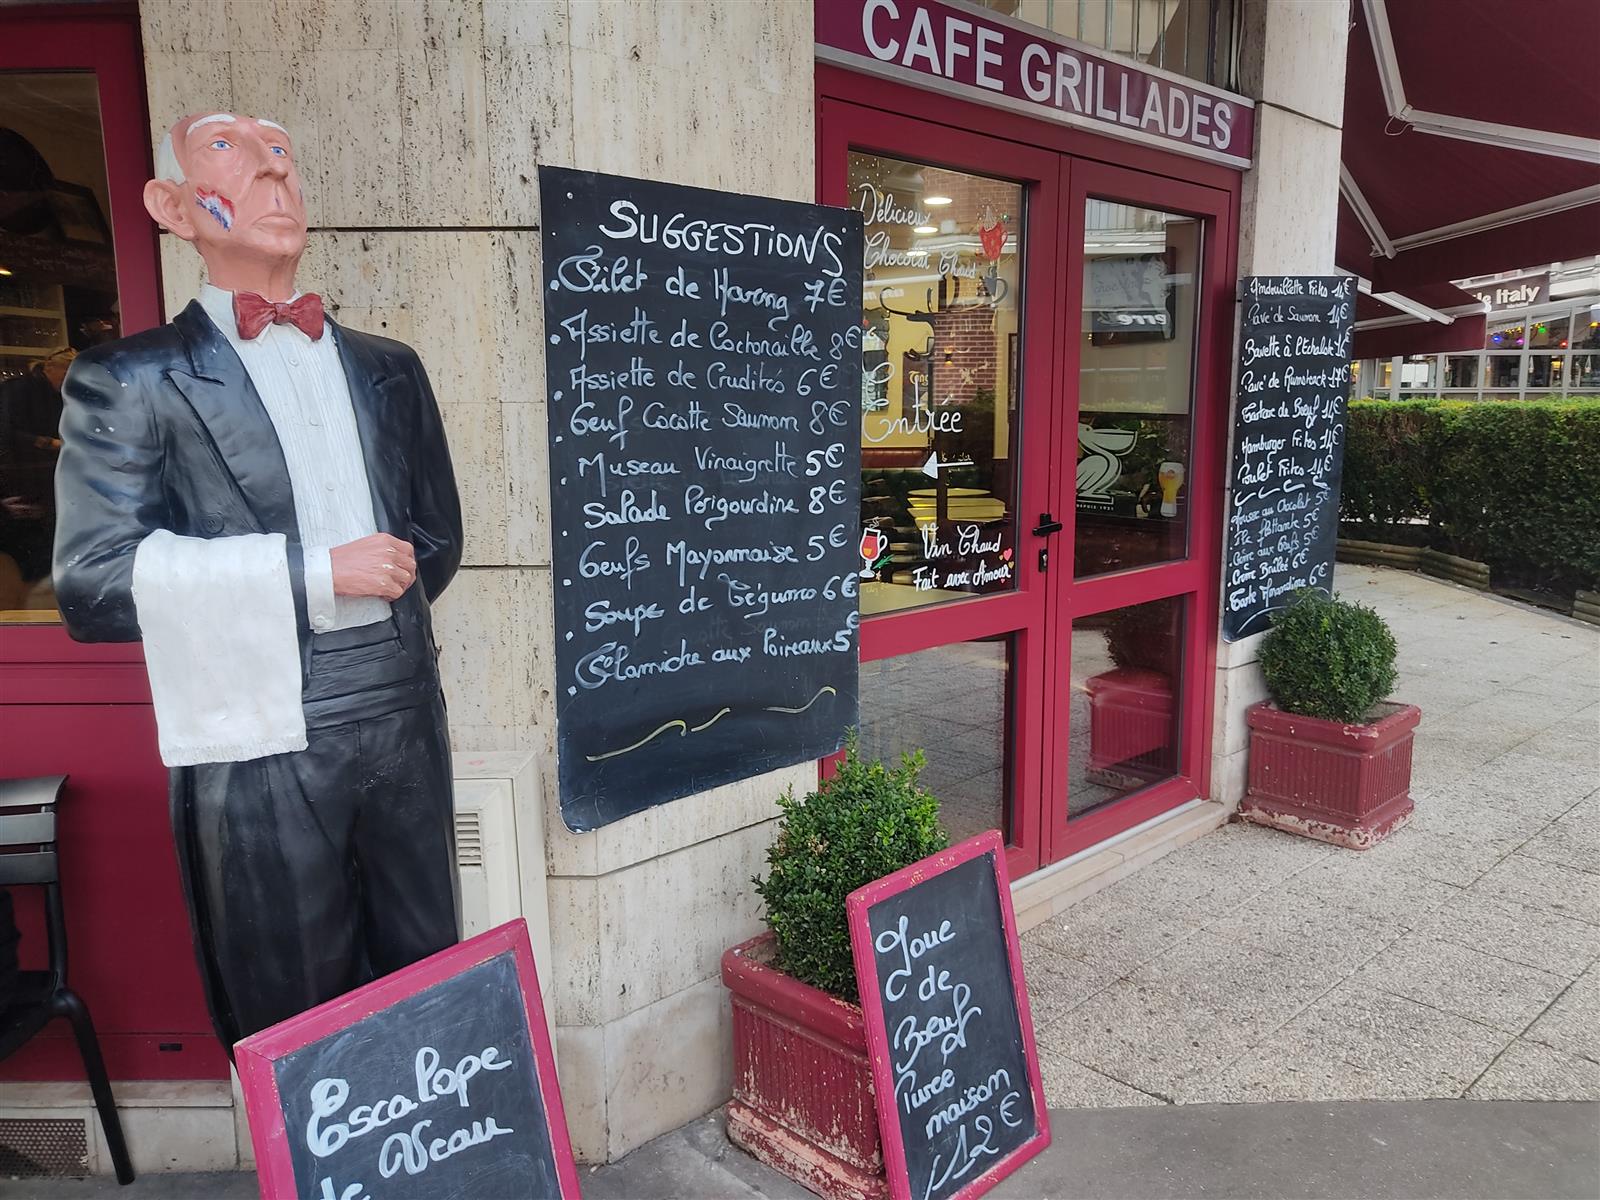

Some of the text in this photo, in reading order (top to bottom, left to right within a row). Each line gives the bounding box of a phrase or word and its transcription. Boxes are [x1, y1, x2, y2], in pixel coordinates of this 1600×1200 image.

[862, 0, 1231, 149] CAFE GRILLADES
[599, 200, 843, 277] SUGGESTIONS
[863, 231, 977, 279] Chocolat Chaud
[558, 245, 847, 331] Filet de Hareng 7€
[1496, 284, 1540, 304] Italy
[560, 306, 663, 361] Assiette
[670, 318, 703, 350] de
[829, 325, 861, 360] 8€
[1273, 305, 1284, 323] de
[1287, 306, 1320, 322] Saumon
[1244, 335, 1280, 366] Bavette
[570, 357, 656, 404] Assiette
[667, 360, 697, 389] de
[796, 364, 838, 397] 6€
[862, 361, 963, 443] Entrée
[1268, 372, 1280, 388] de
[642, 401, 713, 430] Cocotte
[722, 404, 800, 432] Saumon
[809, 400, 850, 435] 8€
[1278, 401, 1290, 418] de
[578, 441, 845, 497] Museau Vinaigrette 5€
[1241, 433, 1286, 464] Hamburger
[1238, 462, 1273, 485] Poulet
[583, 490, 671, 529] Salade
[808, 480, 846, 514] 8€
[1262, 506, 1274, 517] au
[666, 541, 799, 587] Mayonnaise
[806, 524, 848, 561] 5€
[920, 523, 1002, 560] Vin Chaud
[1257, 546, 1275, 556] aux
[912, 559, 1012, 592] Fait avec Amour
[1259, 577, 1307, 608] Amandine
[1309, 562, 1329, 586] 6€
[584, 601, 665, 636] Soupe
[678, 586, 714, 615] de
[822, 572, 858, 600] 6€
[711, 646, 752, 664] aux
[763, 627, 833, 659] Poireaux
[832, 610, 859, 652] 5€
[875, 915, 956, 1002] Joue
[918, 965, 953, 1001] de
[306, 1047, 513, 1157] Escalope
[926, 1069, 1010, 1140] maison
[378, 1116, 514, 1178] Veau
